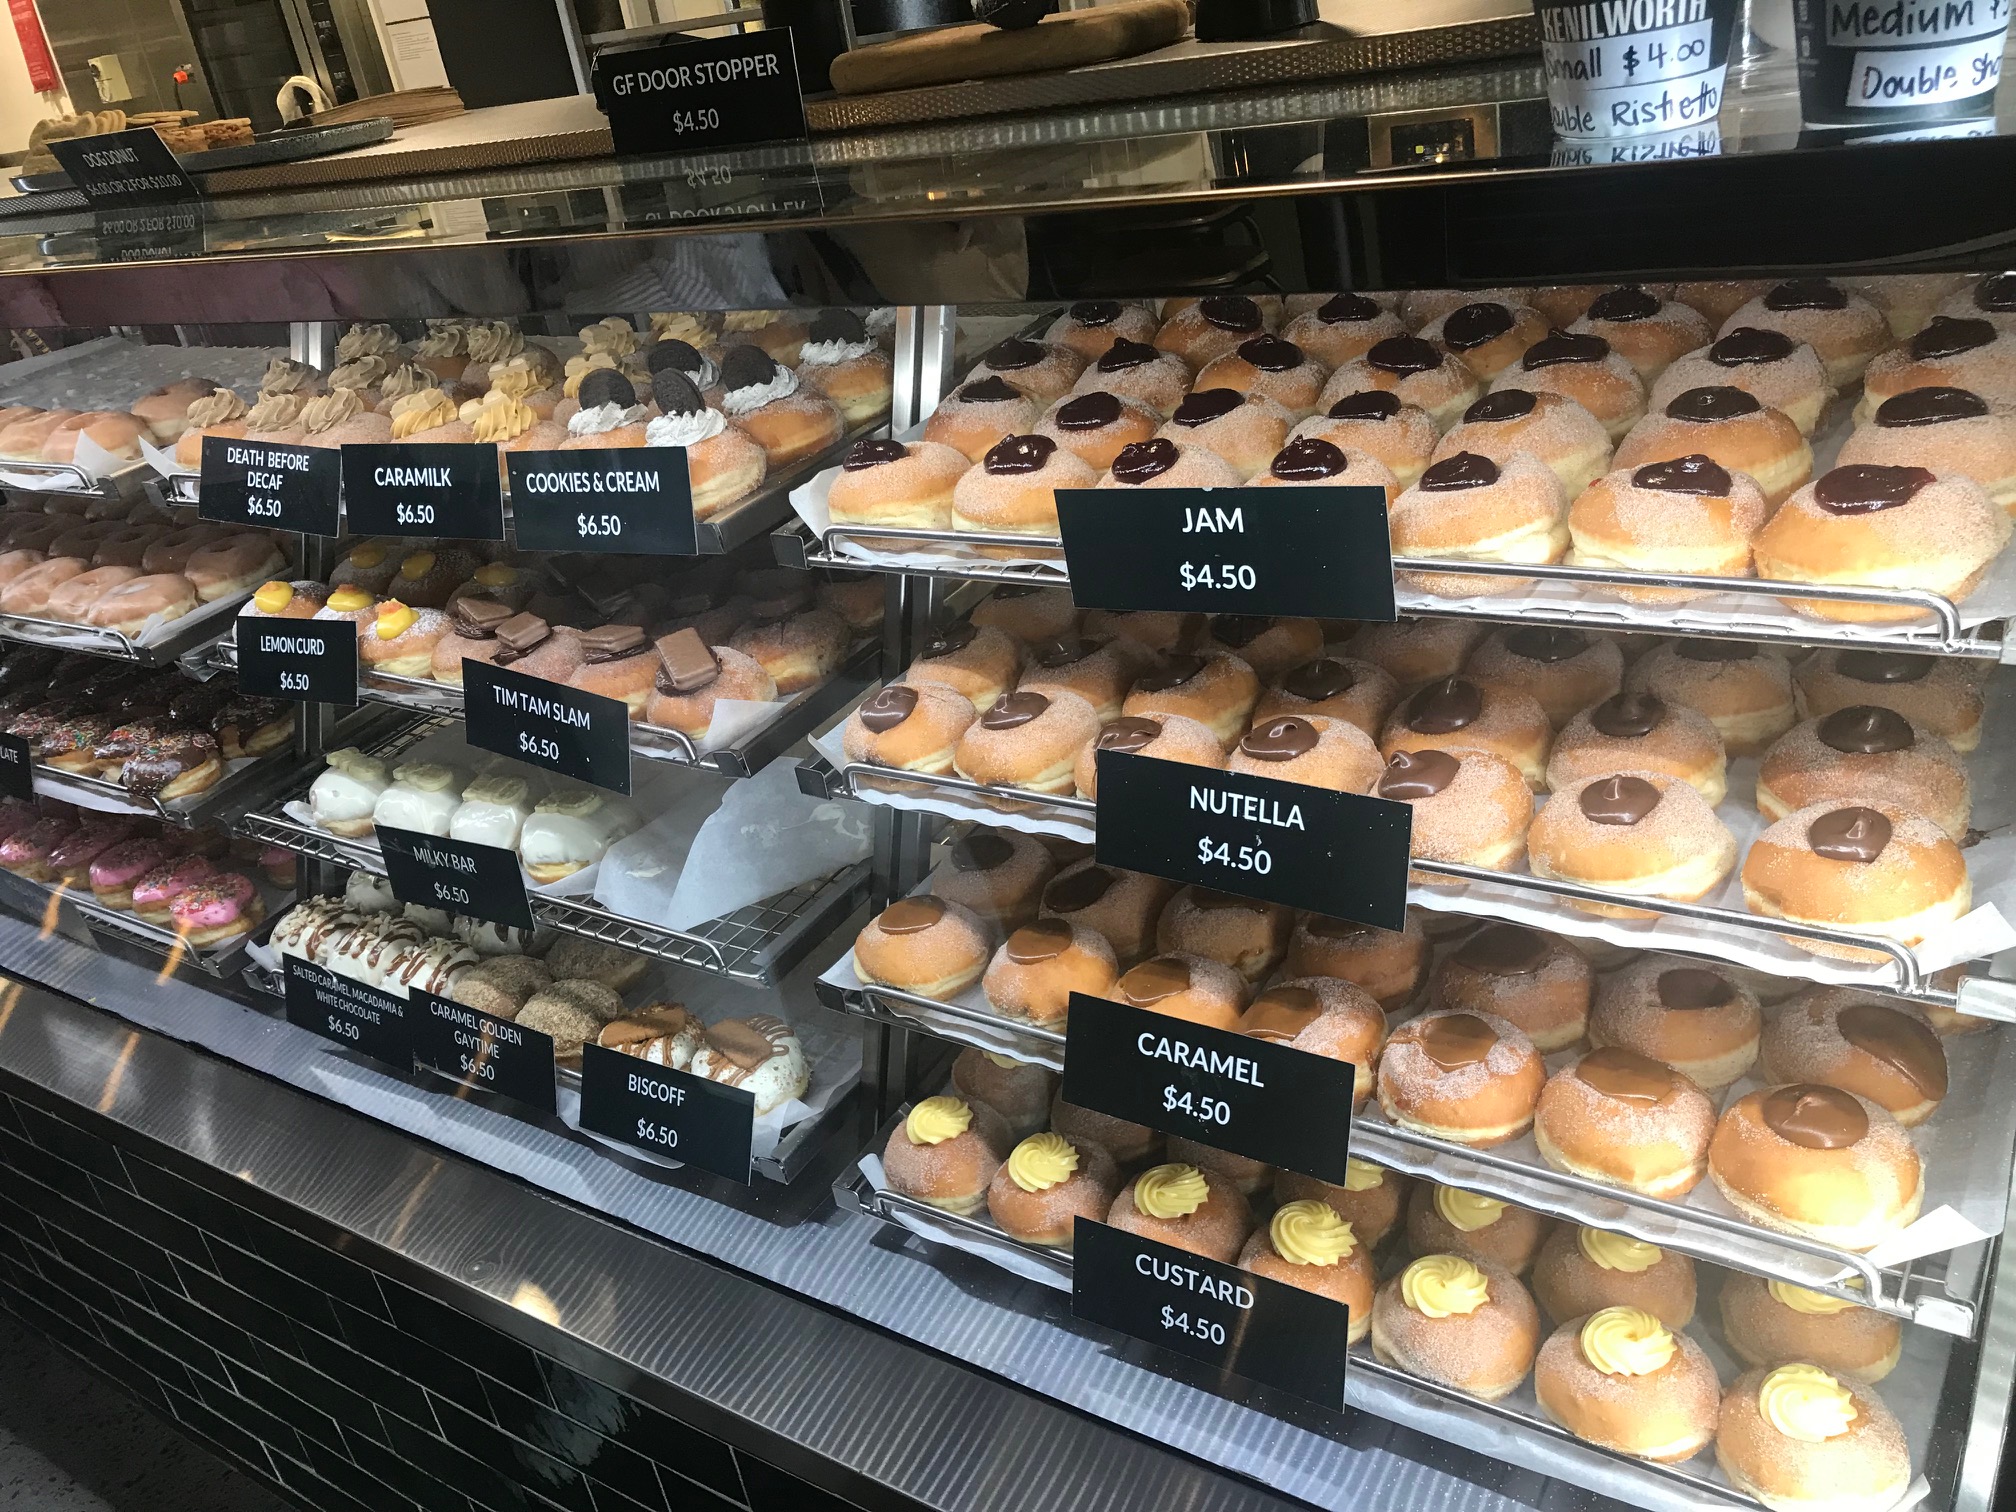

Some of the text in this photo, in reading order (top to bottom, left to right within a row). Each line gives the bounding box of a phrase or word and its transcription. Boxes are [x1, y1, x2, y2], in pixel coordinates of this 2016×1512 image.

[1541, 0, 1707, 41] KENILWORTH
[1831, 0, 1974, 37] Medium
[613, 53, 780, 96] GF DOOR STOPPER
[1862, 52, 2004, 100] Double Sho
[673, 108, 719, 135] $4.50
[1551, 105, 1596, 133] ouble
[82, 148, 140, 168] DOG DONUT
[111, 180, 128, 194] OR
[131, 177, 155, 191] FOR
[149, 173, 183, 190] $10.00
[226, 446, 310, 472] DEATH BEFORE
[247, 470, 283, 491] DECAF
[374, 466, 452, 488] CARAMILK
[526, 470, 660, 494] COOKIES & CREAM
[247, 496, 282, 518] $6.50
[396, 502, 435, 525] $6.50
[1182, 507, 1245, 533] JAM
[577, 513, 622, 537] $6.50
[1179, 561, 1257, 591] $4.50
[260, 635, 325, 656] LEMON CURD
[280, 672, 309, 692] $6.50
[493, 685, 591, 730] TIM TAM SLAM
[0, 745, 18, 764] LATE
[519, 731, 559, 760] $6.50
[1190, 785, 1305, 831] NUTELLA
[413, 846, 477, 874] MILKY BAR
[1197, 836, 1272, 875] $4.50
[434, 881, 469, 904] $6.50
[292, 965, 318, 984] SALTED
[351, 988, 397, 1015] MACADAMIA
[397, 1005, 404, 1018] &
[315, 989, 381, 1025] WHITE CHOCOLATE
[328, 1015, 360, 1040] $6.50
[430, 1001, 522, 1046] CARAMEL GOLDEN
[454, 1030, 500, 1059] GAYTIME
[460, 1053, 495, 1081] $6.50
[1137, 1032, 1265, 1088] CARAMEL
[628, 1073, 686, 1107] BISCOFF
[1162, 1084, 1231, 1125] $4.50
[636, 1117, 678, 1147] $6.50
[1135, 1253, 1255, 1310] CUSTARD
[1160, 1305, 1226, 1345] $4.50
